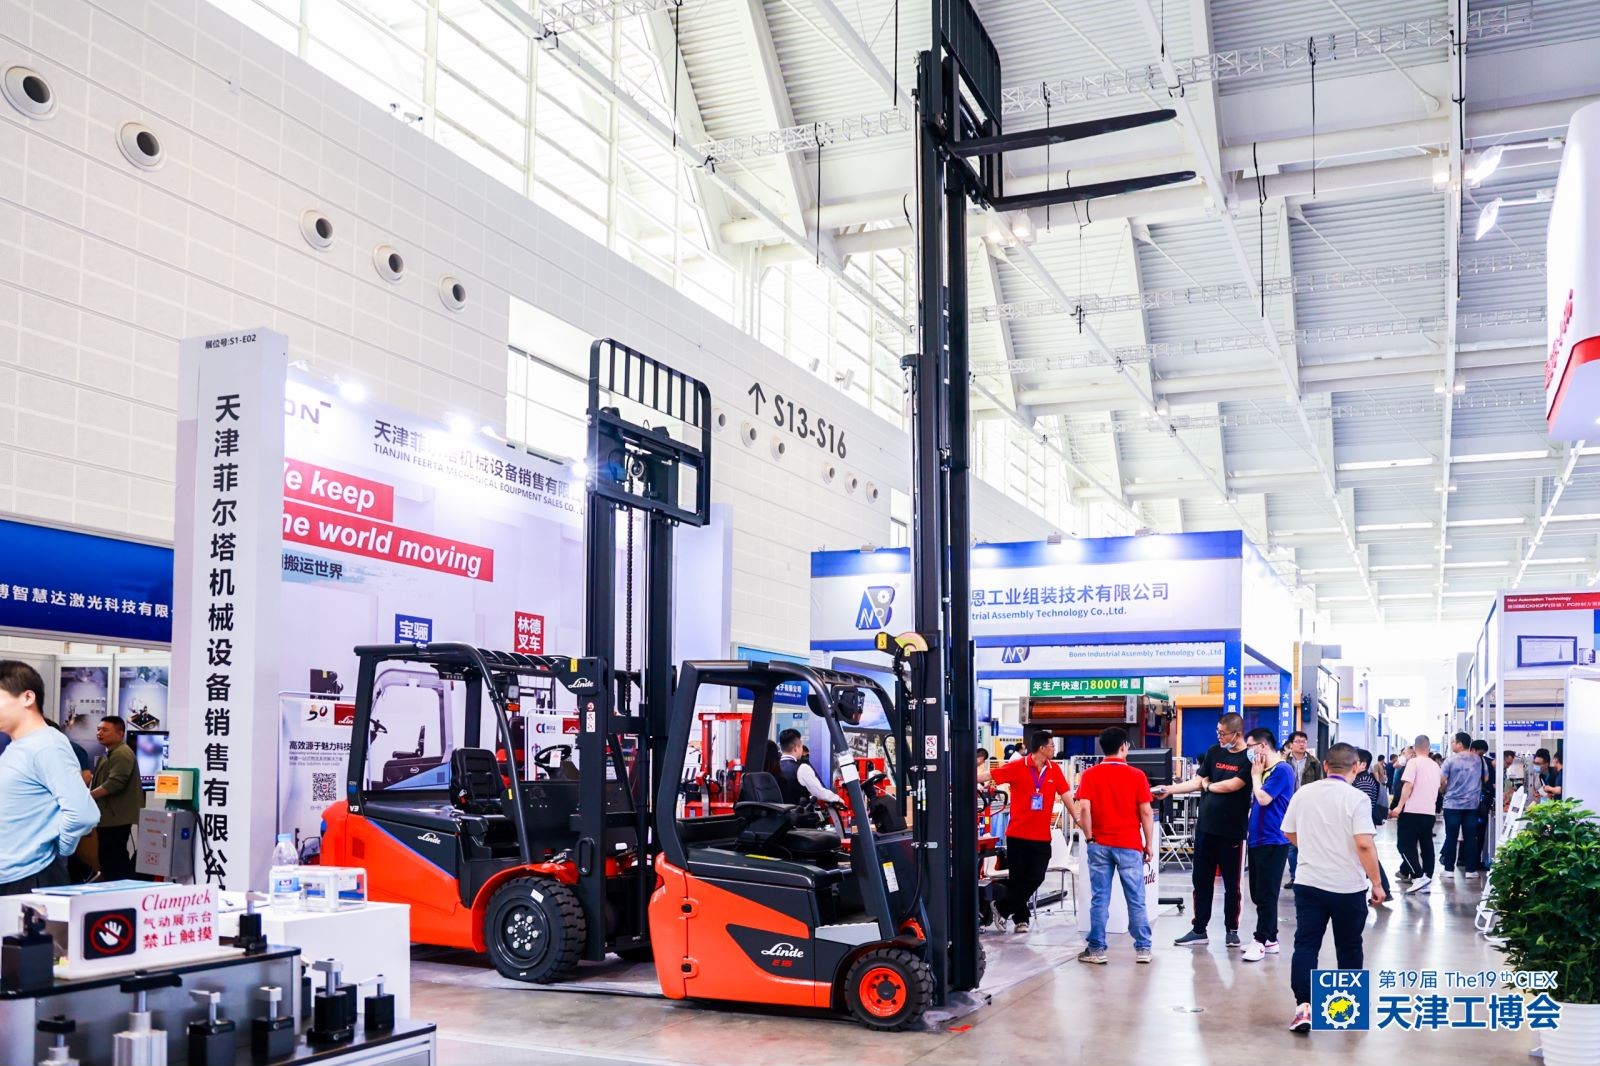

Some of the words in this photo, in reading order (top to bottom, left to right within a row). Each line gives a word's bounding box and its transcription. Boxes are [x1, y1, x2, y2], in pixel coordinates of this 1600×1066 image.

[774, 394, 847, 459] S13-S16
[374, 443, 410, 462] TIANJIN
[500, 482, 542, 502] EQUIPMENT
[543, 495, 563, 509] SALES
[310, 470, 375, 512] keep
[318, 521, 393, 554] world
[397, 539, 482, 577] moving
[282, 554, 343, 580] 搬运世界
[0, 583, 173, 618] 博智慧达激光科技有限
[992, 609, 1033, 621] Assembly
[1036, 607, 1087, 619] Technology
[398, 620, 428, 641] 宝骊
[517, 616, 542, 634] 林德
[518, 634, 541, 652] 叉车
[1121, 650, 1153, 658] Assembly
[1155, 649, 1195, 657] Technology
[568, 677, 594, 689] Linde
[418, 832, 441, 845] Linde
[142, 889, 212, 912] Clamptek
[143, 912, 213, 930] 气动展示台
[143, 927, 213, 949] 禁止触摸
[761, 942, 804, 958] Linde
